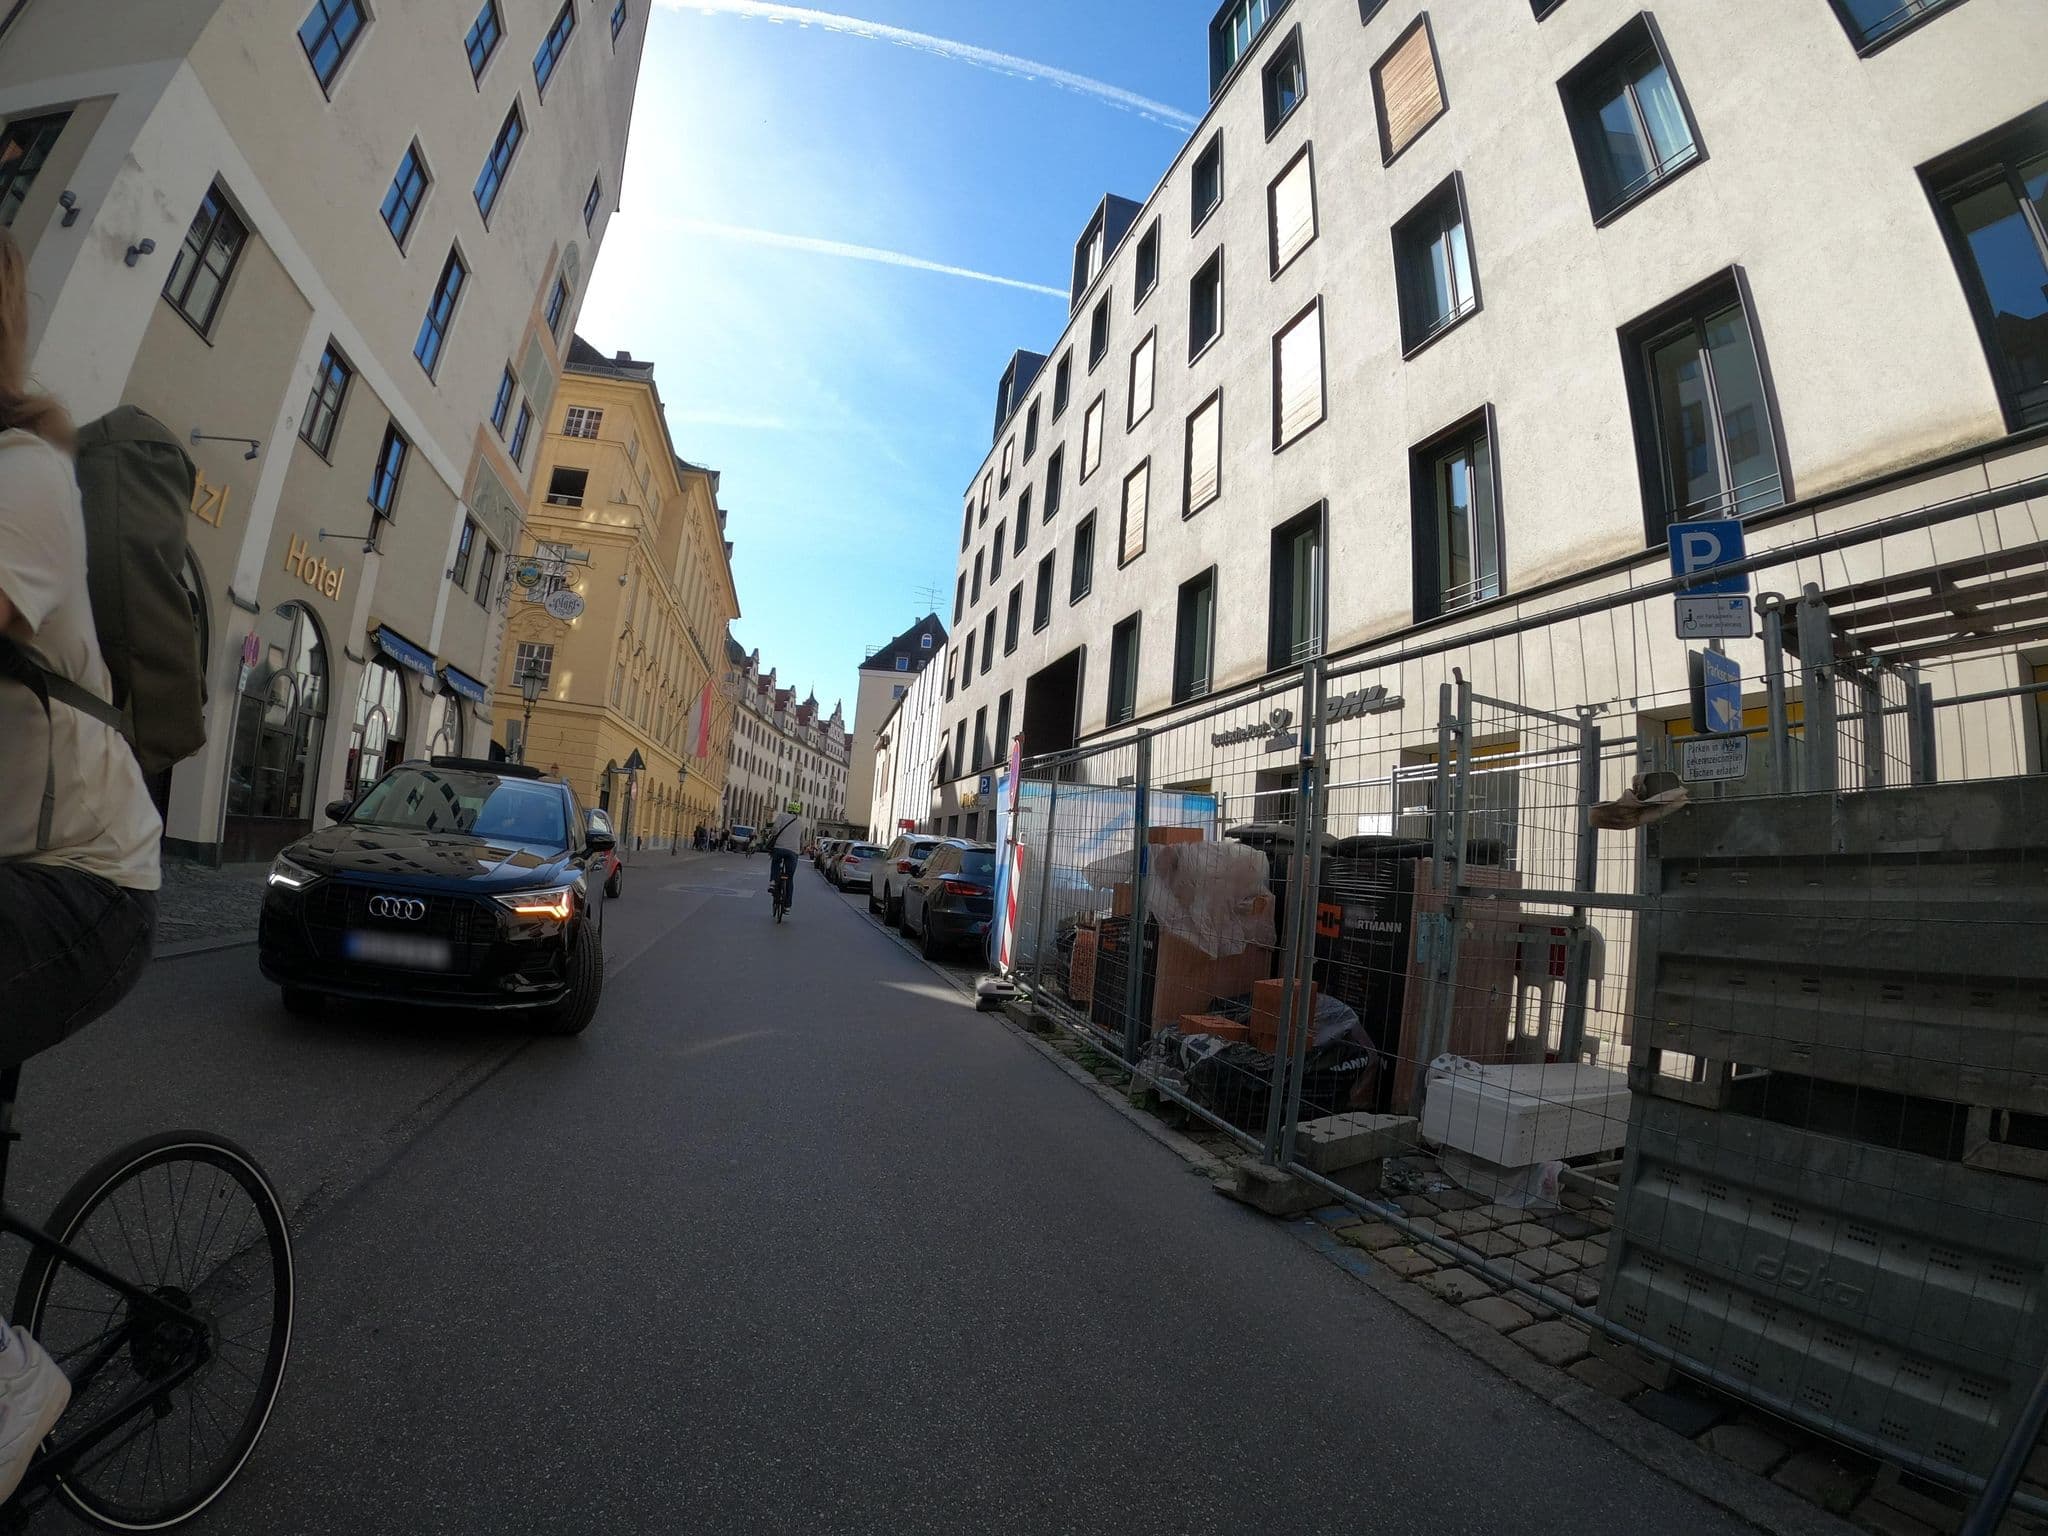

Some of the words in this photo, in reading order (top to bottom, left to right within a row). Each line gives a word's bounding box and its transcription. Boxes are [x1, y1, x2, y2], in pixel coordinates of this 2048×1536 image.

[285, 532, 344, 600] Hotel
[1681, 532, 1721, 577] P
[1326, 685, 1396, 724] DHL
[1688, 743, 1710, 753] Parken
[1344, 918, 1402, 933] RTMANN
